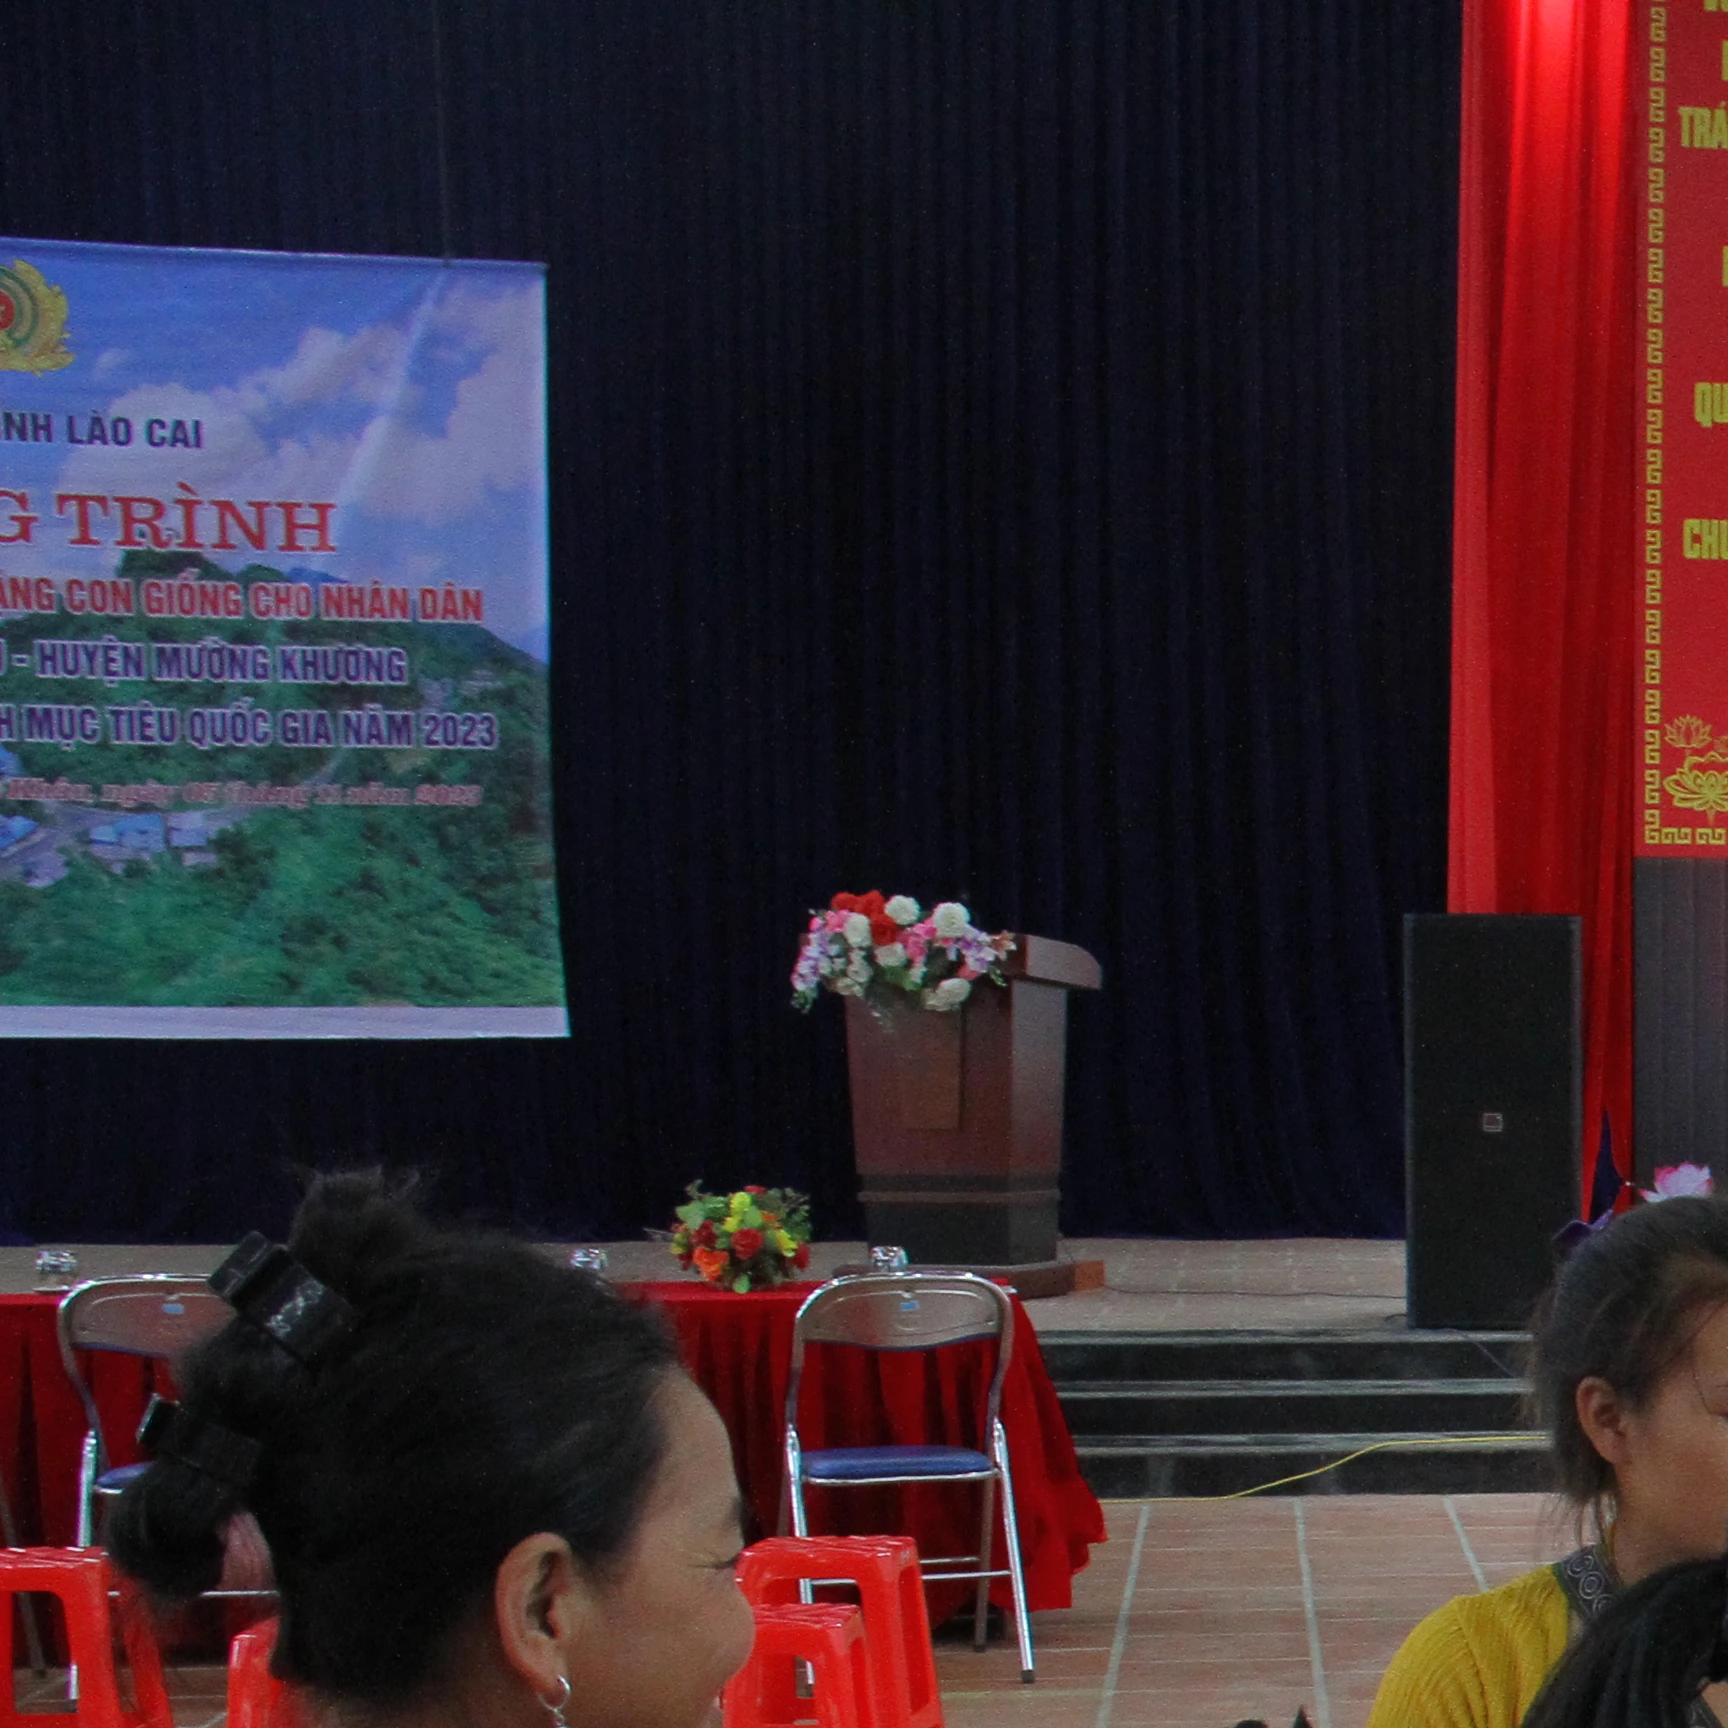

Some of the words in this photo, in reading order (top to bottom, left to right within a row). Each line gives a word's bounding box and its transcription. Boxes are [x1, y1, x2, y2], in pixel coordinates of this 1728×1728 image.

[66, 408, 132, 446] LÀO
[148, 417, 204, 449] CAI
[56, 480, 337, 553] TRÌNH
[66, 579, 134, 613] CON
[145, 568, 242, 616] GIỐNG
[253, 582, 312, 618] CHO
[323, 580, 410, 620] NHÂN
[420, 582, 482, 621] DÂN
[38, 636, 145, 685] HUYỆN
[156, 637, 270, 682] MƯỜNG
[282, 645, 406, 683] KHƯƠNG
[26, 706, 99, 749] MỤC
[111, 701, 177, 743] TIÊU
[190, 698, 270, 748] QUỐC
[281, 712, 333, 746] GIA
[343, 703, 414, 747] NĂM
[423, 713, 496, 748] 2023
